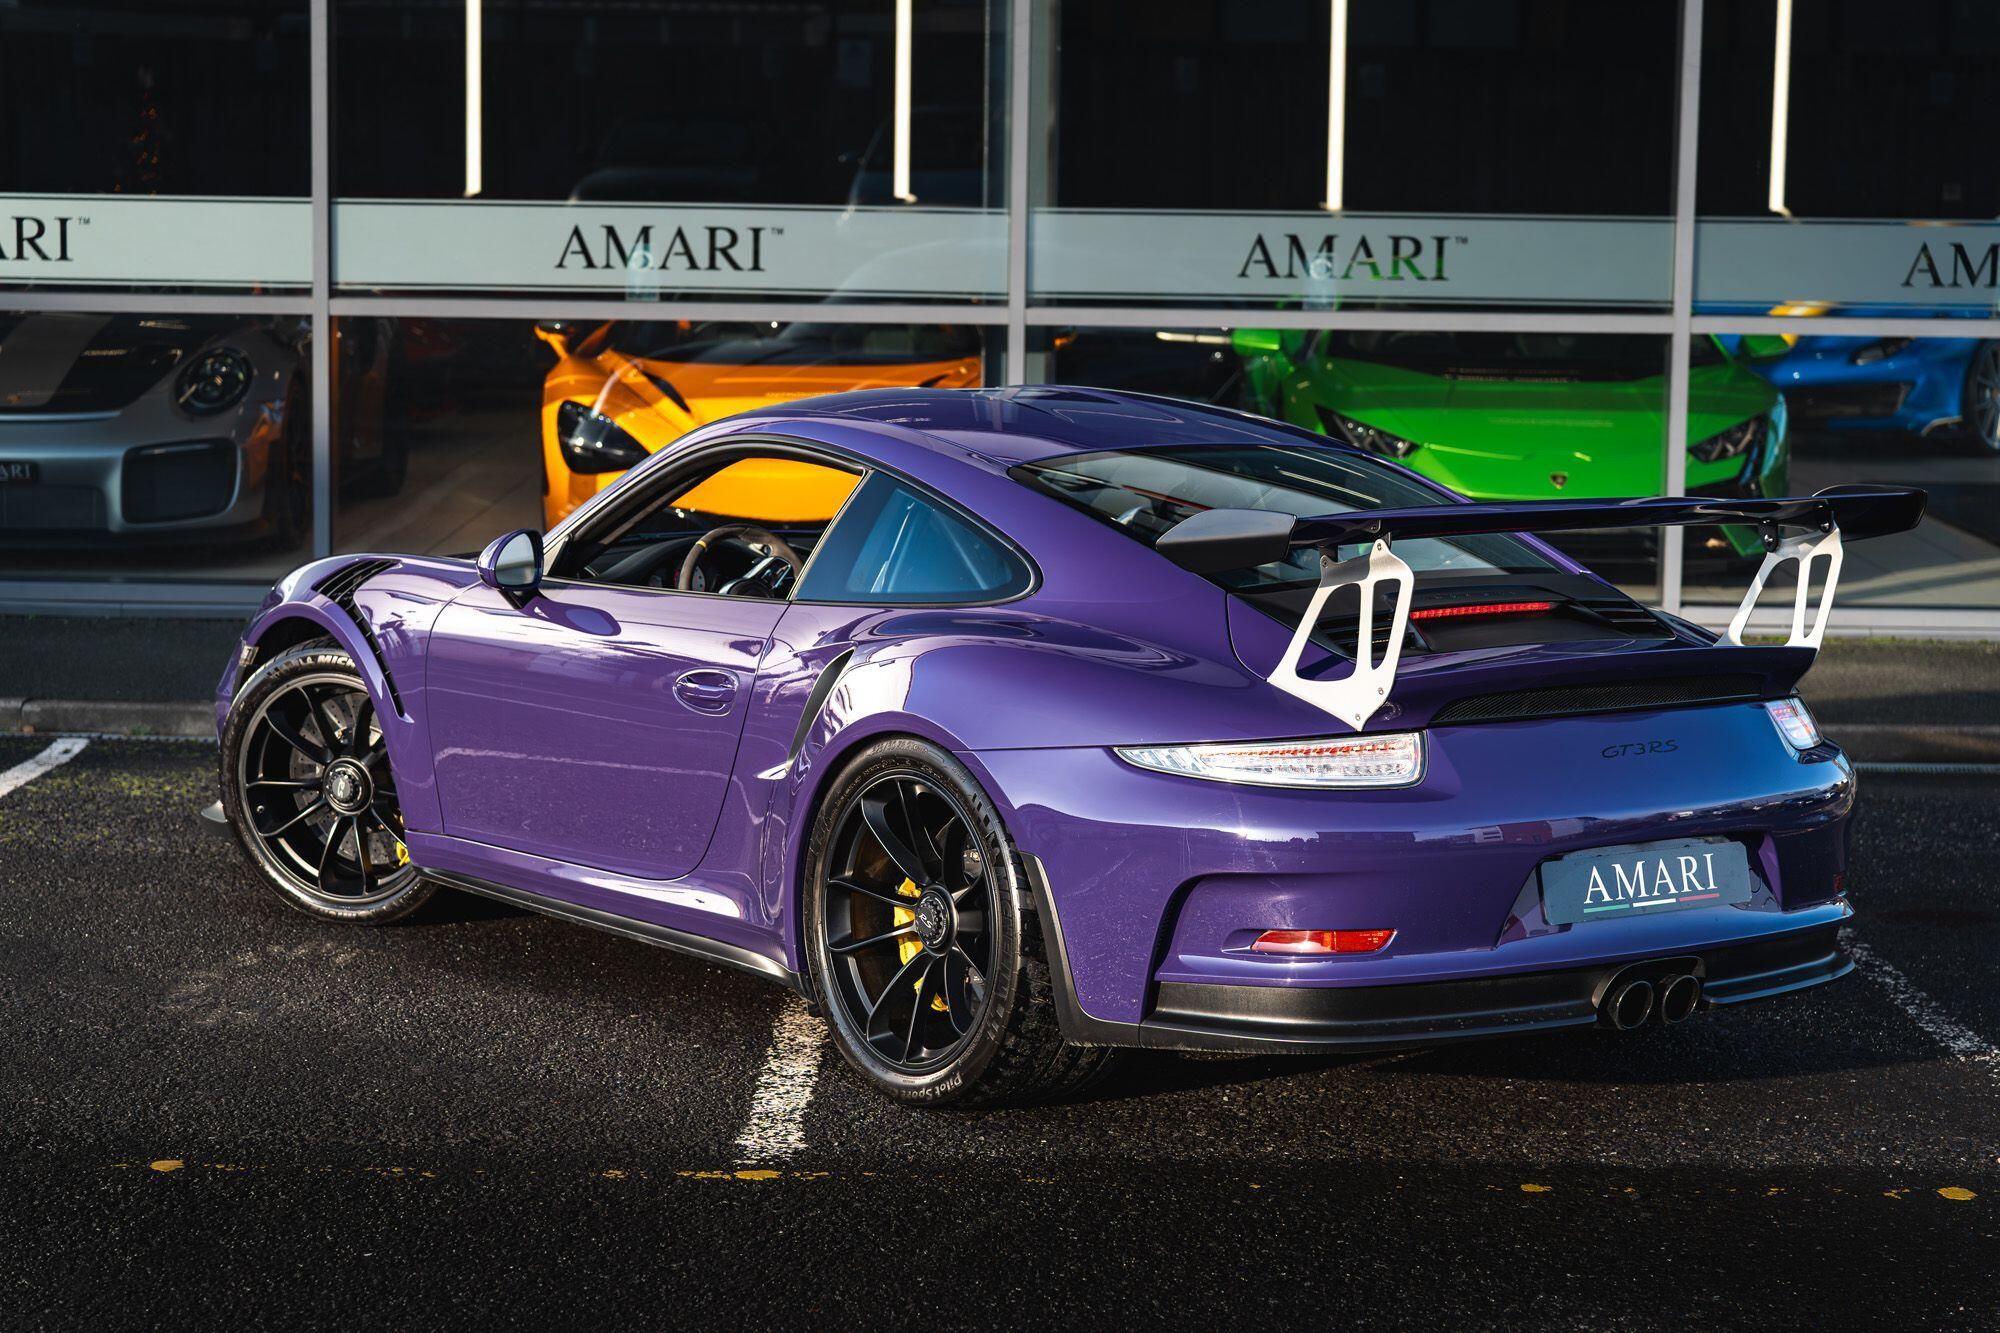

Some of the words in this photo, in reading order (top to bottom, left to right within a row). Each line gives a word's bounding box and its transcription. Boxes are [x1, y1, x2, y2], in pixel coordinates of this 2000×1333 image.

[554, 223, 766, 272] AMARI
[1237, 233, 1450, 281] AMARI
[1583, 853, 1718, 904] AMARI
